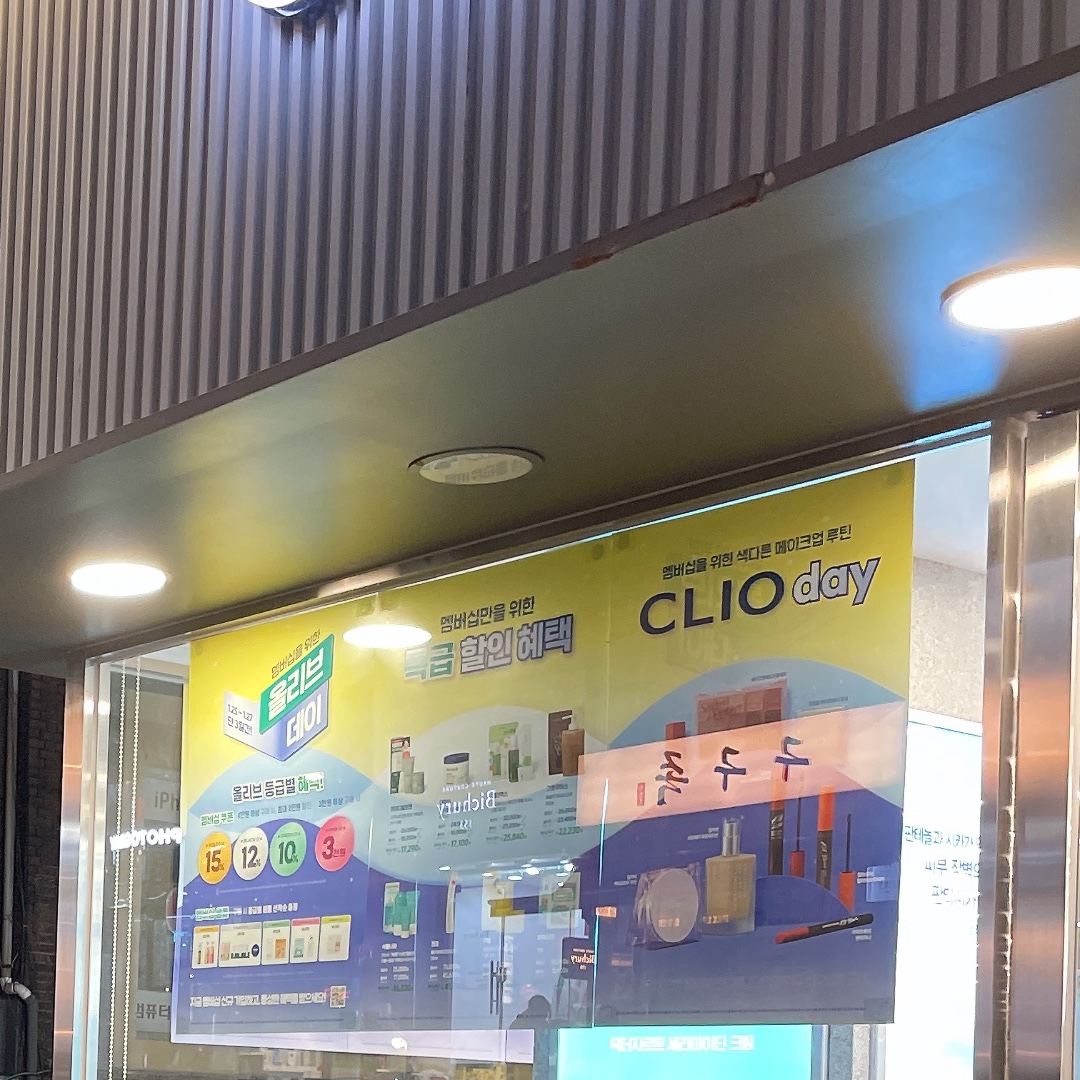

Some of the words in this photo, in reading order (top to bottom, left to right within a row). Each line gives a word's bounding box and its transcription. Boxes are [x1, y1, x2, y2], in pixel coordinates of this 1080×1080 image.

[662, 557, 707, 580] 멤버십을
[710, 551, 734, 570] 위한
[736, 543, 772, 563] 색다른
[775, 531, 824, 555] 메이크업
[826, 524, 852, 544] 루틴
[441, 603, 506, 634] 멤버십만을
[509, 596, 535, 619] 위한
[639, 571, 785, 636] CLIO
[792, 557, 882, 606] day
[272, 644, 304, 679] 멤버십을
[304, 629, 321, 652] 위한
[460, 627, 514, 675] 할인
[516, 613, 573, 662] 혜택
[267, 647, 324, 721] 올리브
[286, 693, 322, 748] 데이
[233, 784, 263, 803] 올리브
[265, 777, 296, 798] 등급별
[242, 845, 261, 869] 12%
[279, 841, 299, 865] 10%
